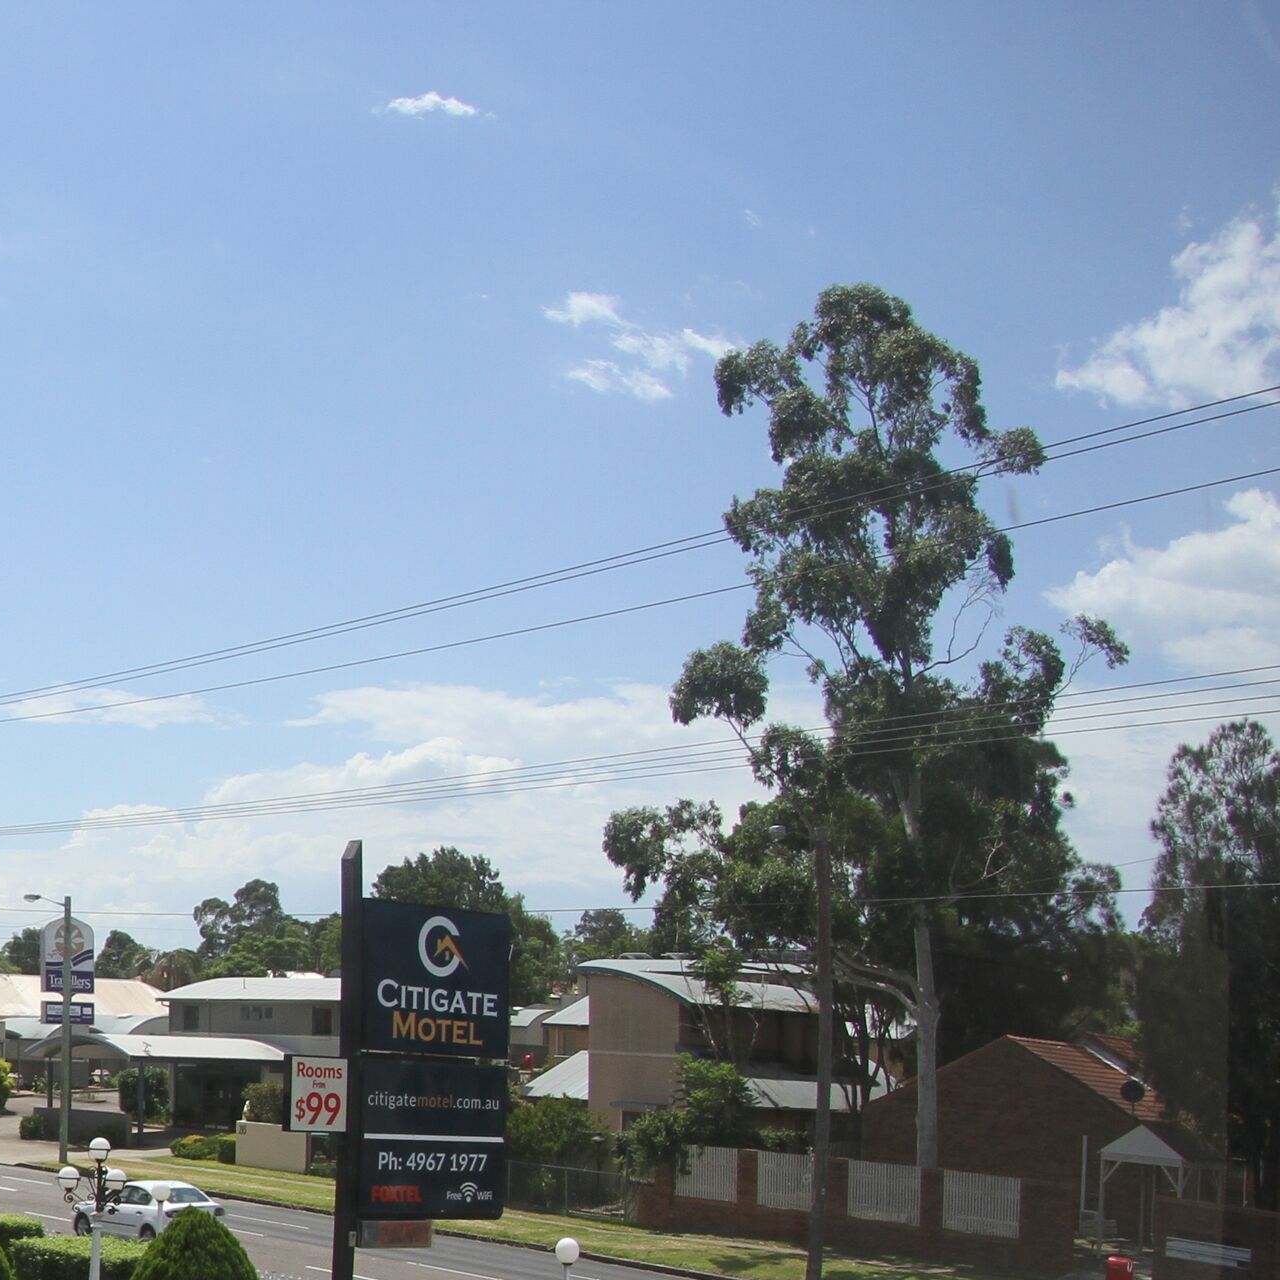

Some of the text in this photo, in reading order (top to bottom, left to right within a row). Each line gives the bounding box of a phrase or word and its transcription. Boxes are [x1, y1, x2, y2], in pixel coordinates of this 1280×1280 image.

[48, 974, 91, 989] Trallers
[377, 979, 498, 1017] CITIGATE
[392, 1011, 483, 1045] MOTEL
[297, 1062, 343, 1079] Rooms
[294, 1092, 342, 1125] $99
[367, 1091, 500, 1110] citigatemotel.com.au
[378, 1151, 487, 1172] Ph: 4967 1977
[371, 1185, 422, 1202] FOXTEL
[446, 1191, 462, 1200] Free
